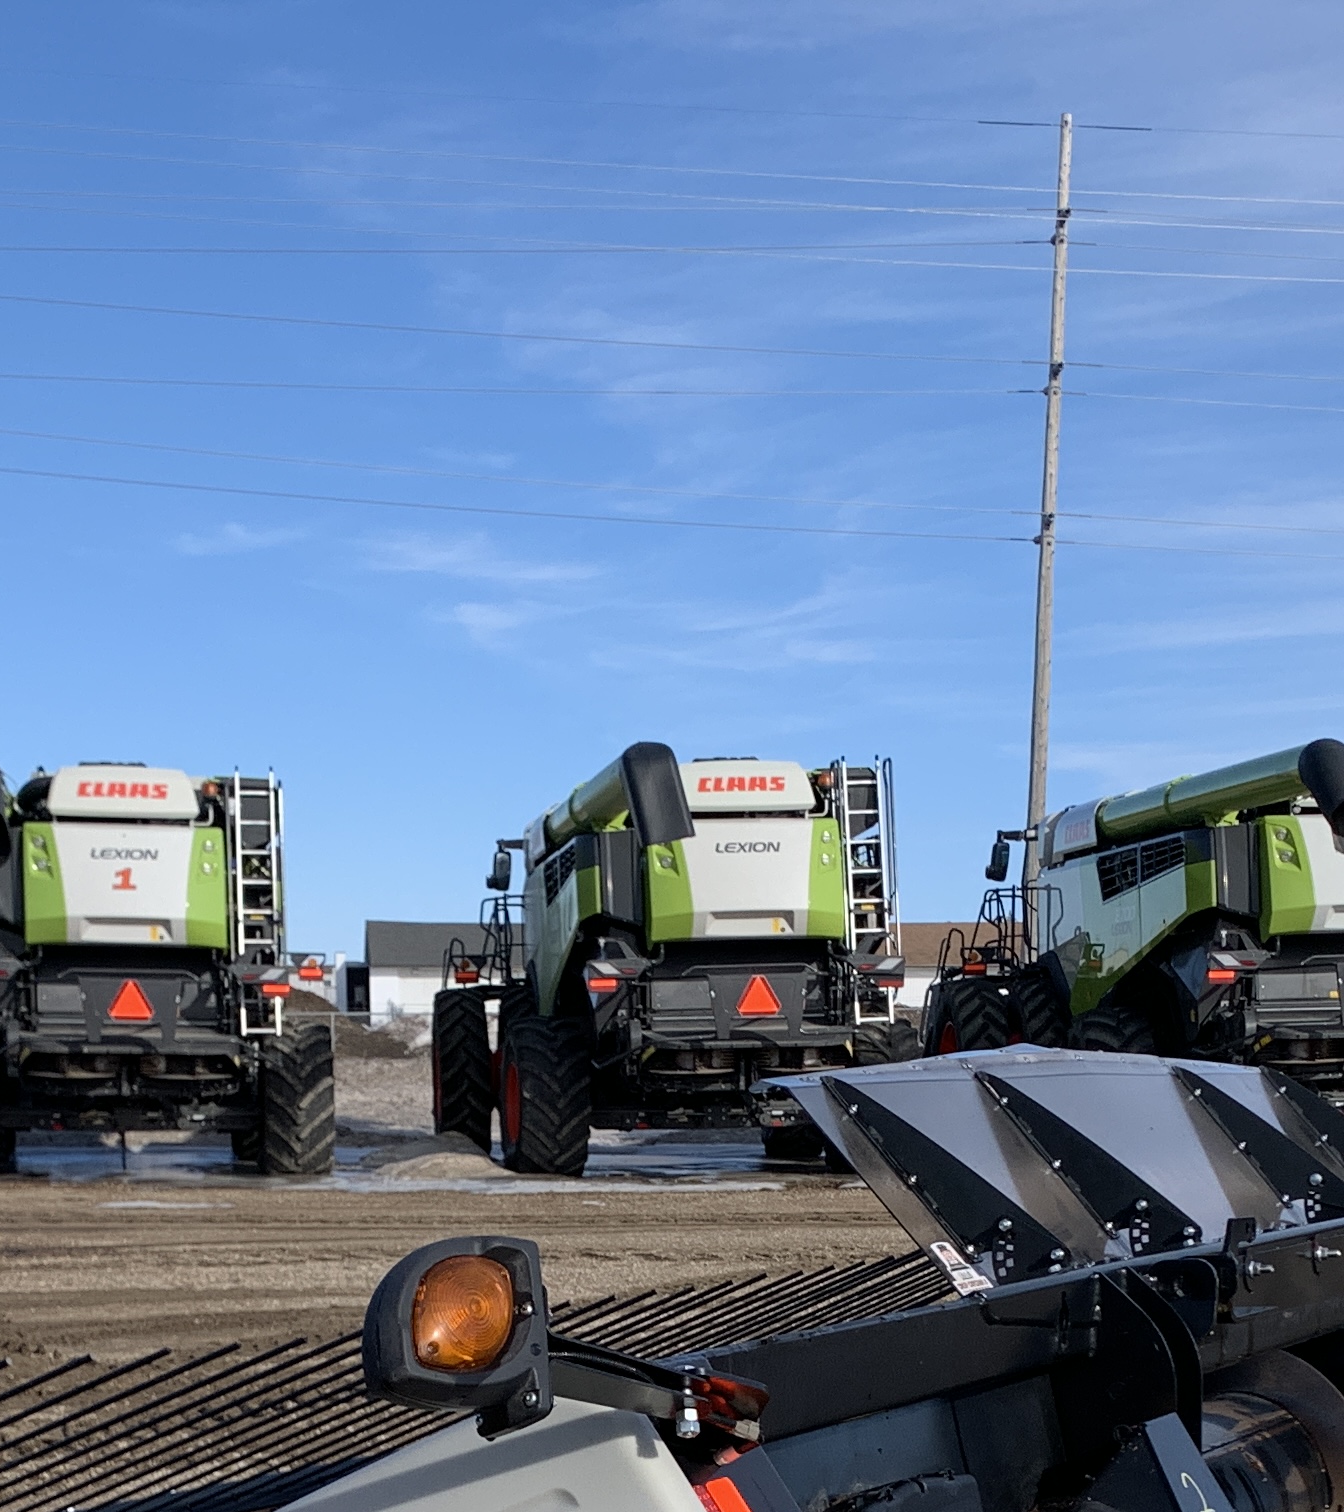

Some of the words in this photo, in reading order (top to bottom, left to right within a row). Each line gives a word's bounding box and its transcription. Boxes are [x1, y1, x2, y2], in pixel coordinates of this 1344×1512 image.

[77, 782, 168, 800] CLAAS
[697, 776, 785, 793] CLAAS
[90, 847, 159, 860] LEXION
[715, 842, 781, 853] LEXION
[111, 867, 137, 890] 1
